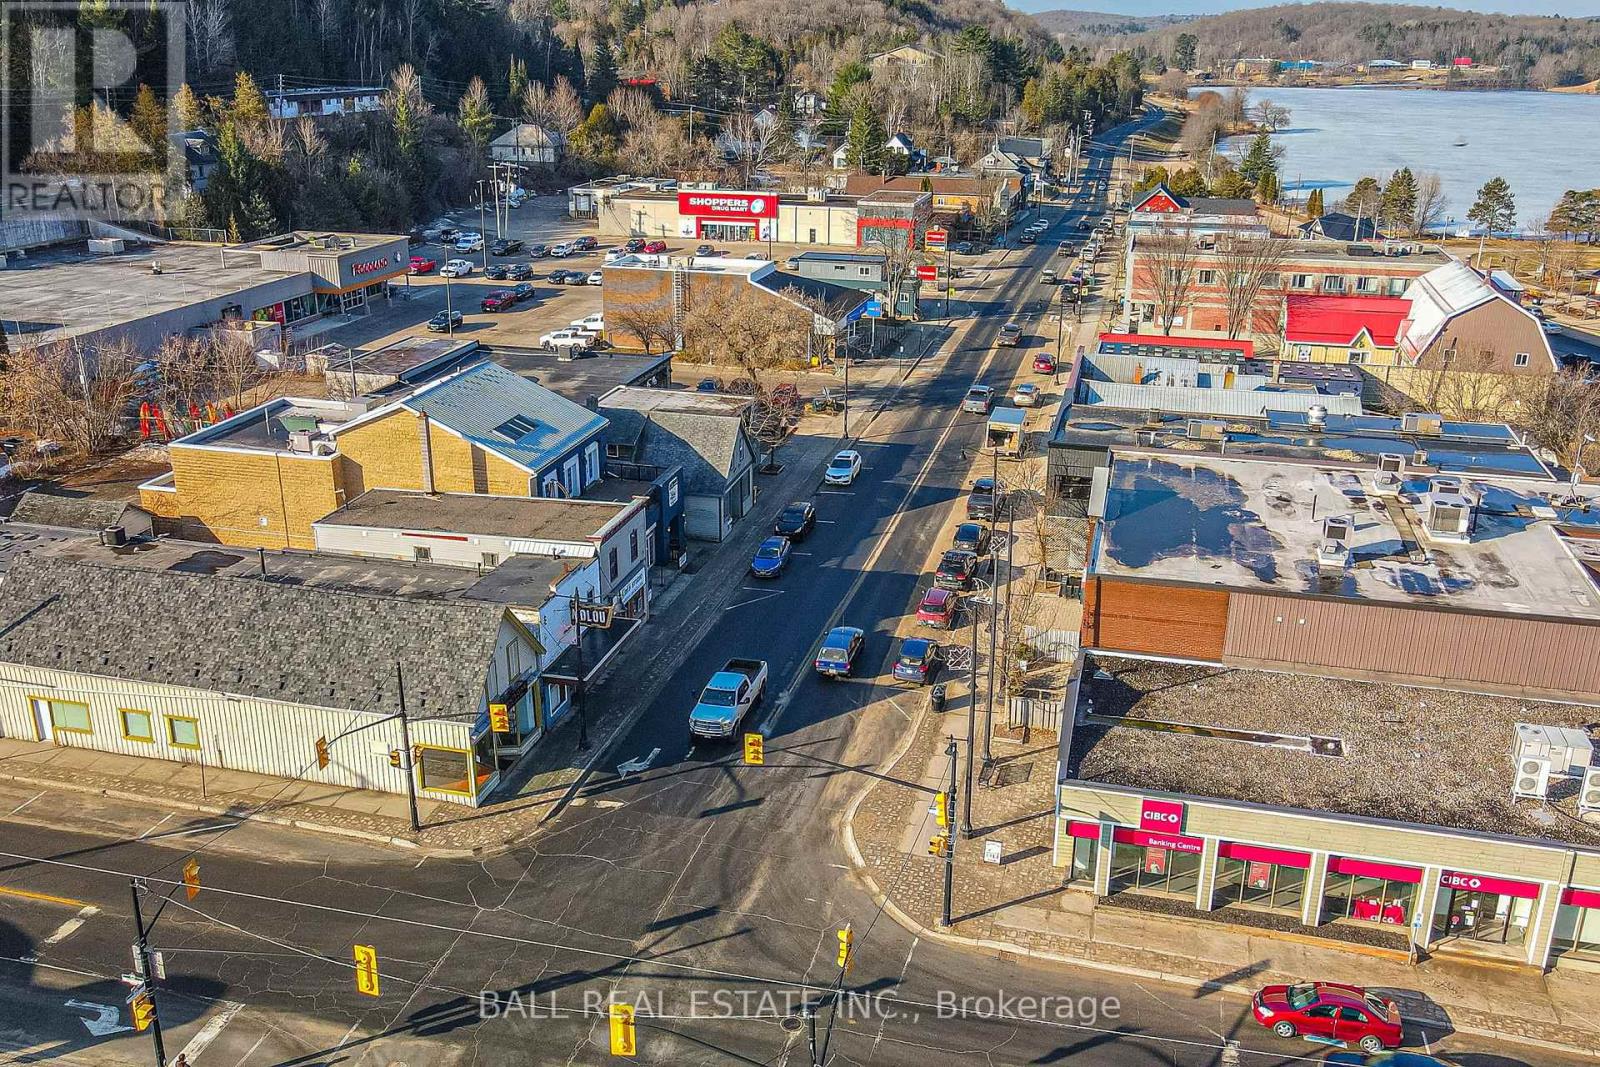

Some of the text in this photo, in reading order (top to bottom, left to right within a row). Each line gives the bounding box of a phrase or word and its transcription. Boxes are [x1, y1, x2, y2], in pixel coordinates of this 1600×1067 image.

[689, 198, 748, 206] SHOPPERS
[1144, 811, 1168, 822] CIBC
[1148, 838, 1201, 851] Banking Centre
[1441, 875, 1468, 887] CIBC
